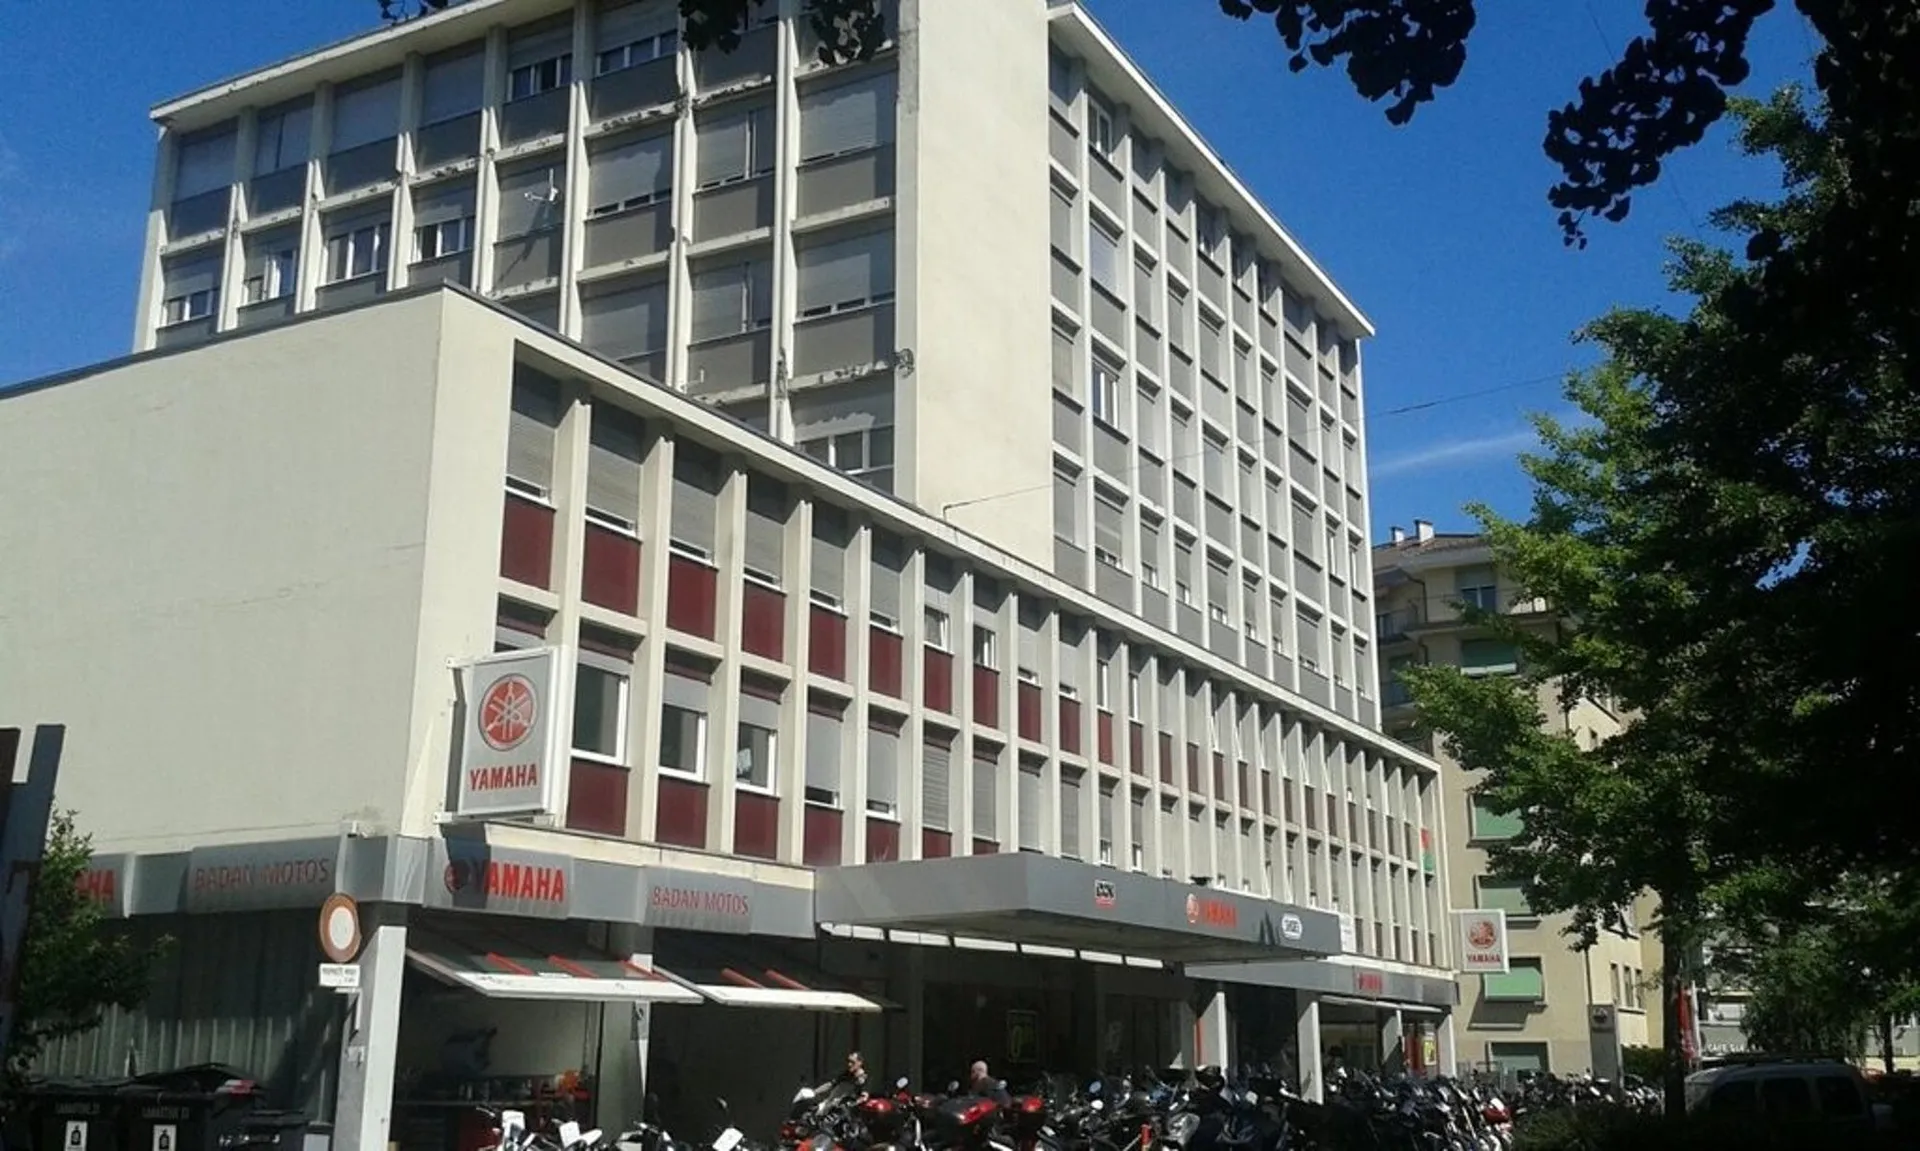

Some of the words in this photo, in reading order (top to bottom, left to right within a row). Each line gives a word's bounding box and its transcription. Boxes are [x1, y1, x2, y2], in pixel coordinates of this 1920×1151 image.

[469, 763, 538, 792] YAMAHA
[74, 868, 116, 903] AHA
[194, 864, 255, 891] BADAN
[260, 858, 330, 885] MOTOS
[472, 860, 564, 902] YAMAHA
[653, 885, 700, 910] BADAN
[704, 891, 749, 916] MOTOS
